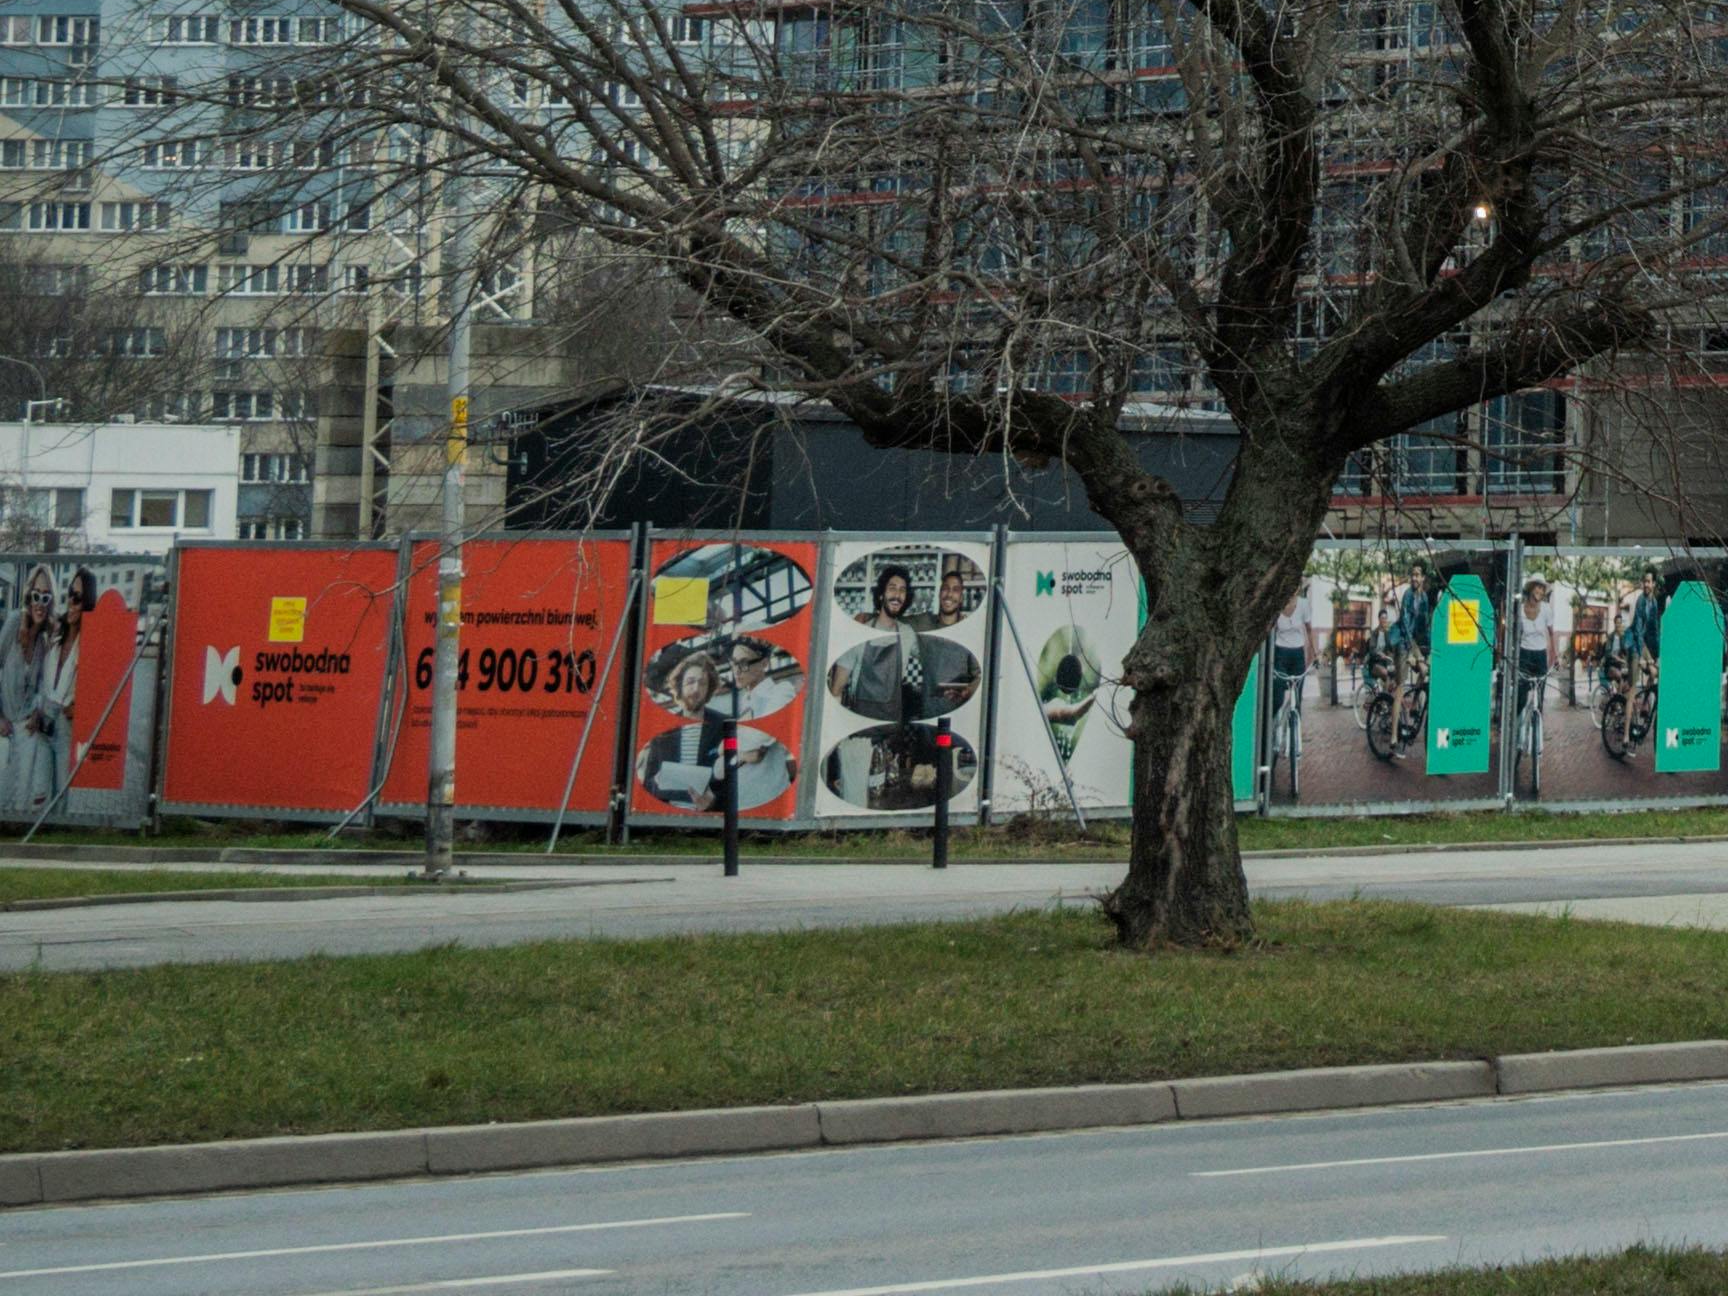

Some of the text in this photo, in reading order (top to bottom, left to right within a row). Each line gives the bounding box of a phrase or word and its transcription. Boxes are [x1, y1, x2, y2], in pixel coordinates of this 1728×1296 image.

[1061, 569, 1112, 581] swobodna
[1061, 583, 1083, 597] spot
[476, 608, 546, 627] powierzchni
[255, 646, 350, 674] swobodna
[416, 647, 597, 694] 64 900 310
[252, 677, 295, 708] spot
